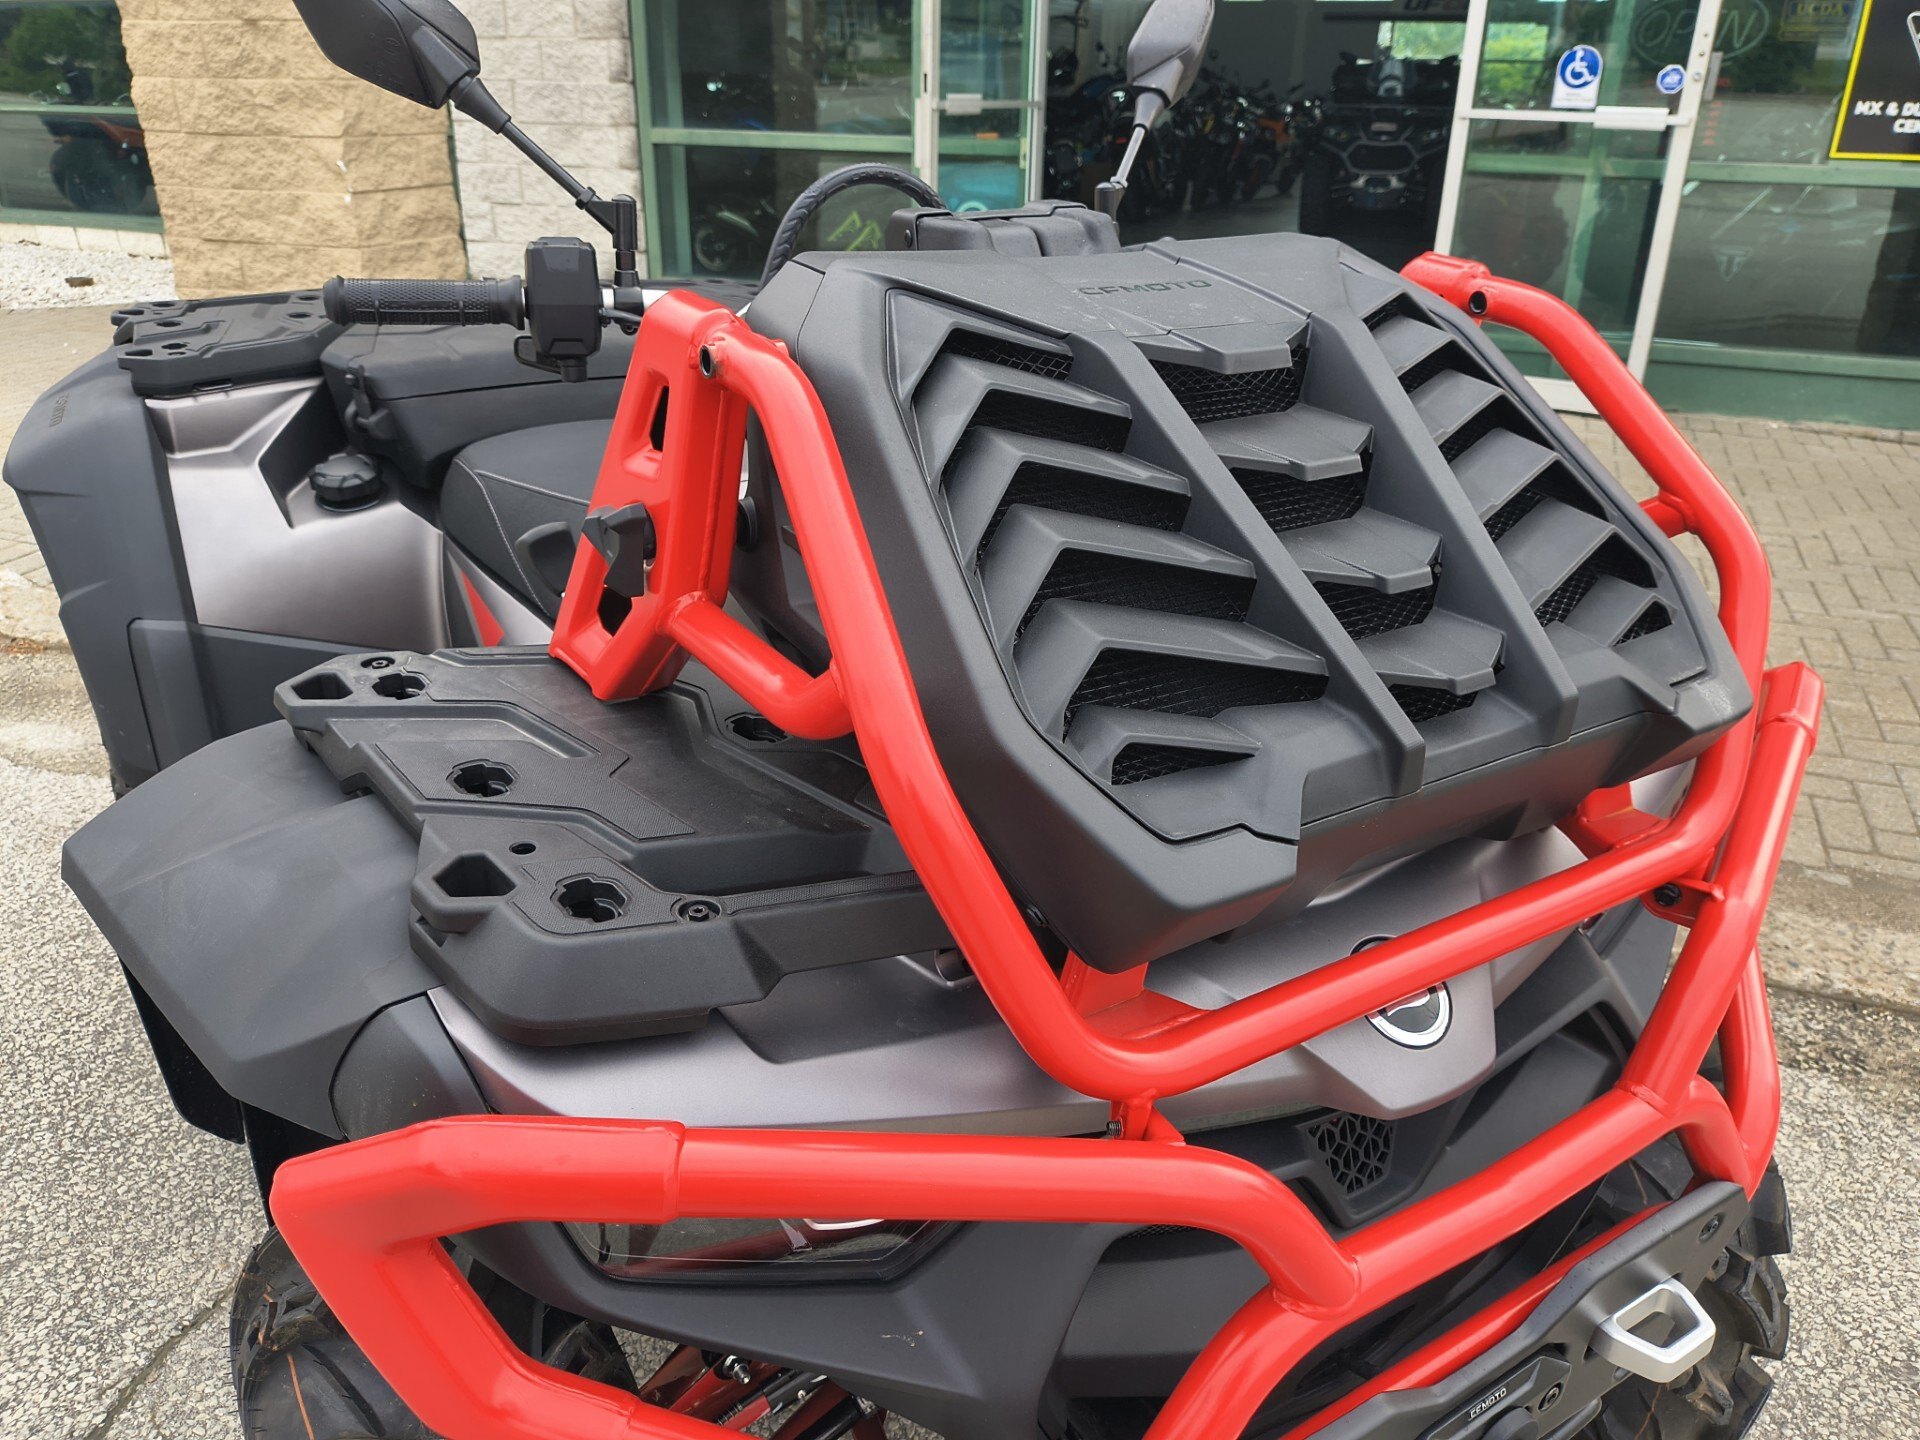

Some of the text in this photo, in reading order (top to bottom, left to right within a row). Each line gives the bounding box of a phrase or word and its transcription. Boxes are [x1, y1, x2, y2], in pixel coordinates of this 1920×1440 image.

[1796, 2, 1845, 16] UCDA
[1638, 8, 1758, 50] OPN
[1854, 100, 1885, 117] MX
[1885, 101, 1900, 117] &
[1079, 279, 1213, 296] CFMOTO
[1470, 1387, 1507, 1418] CFMOTO
